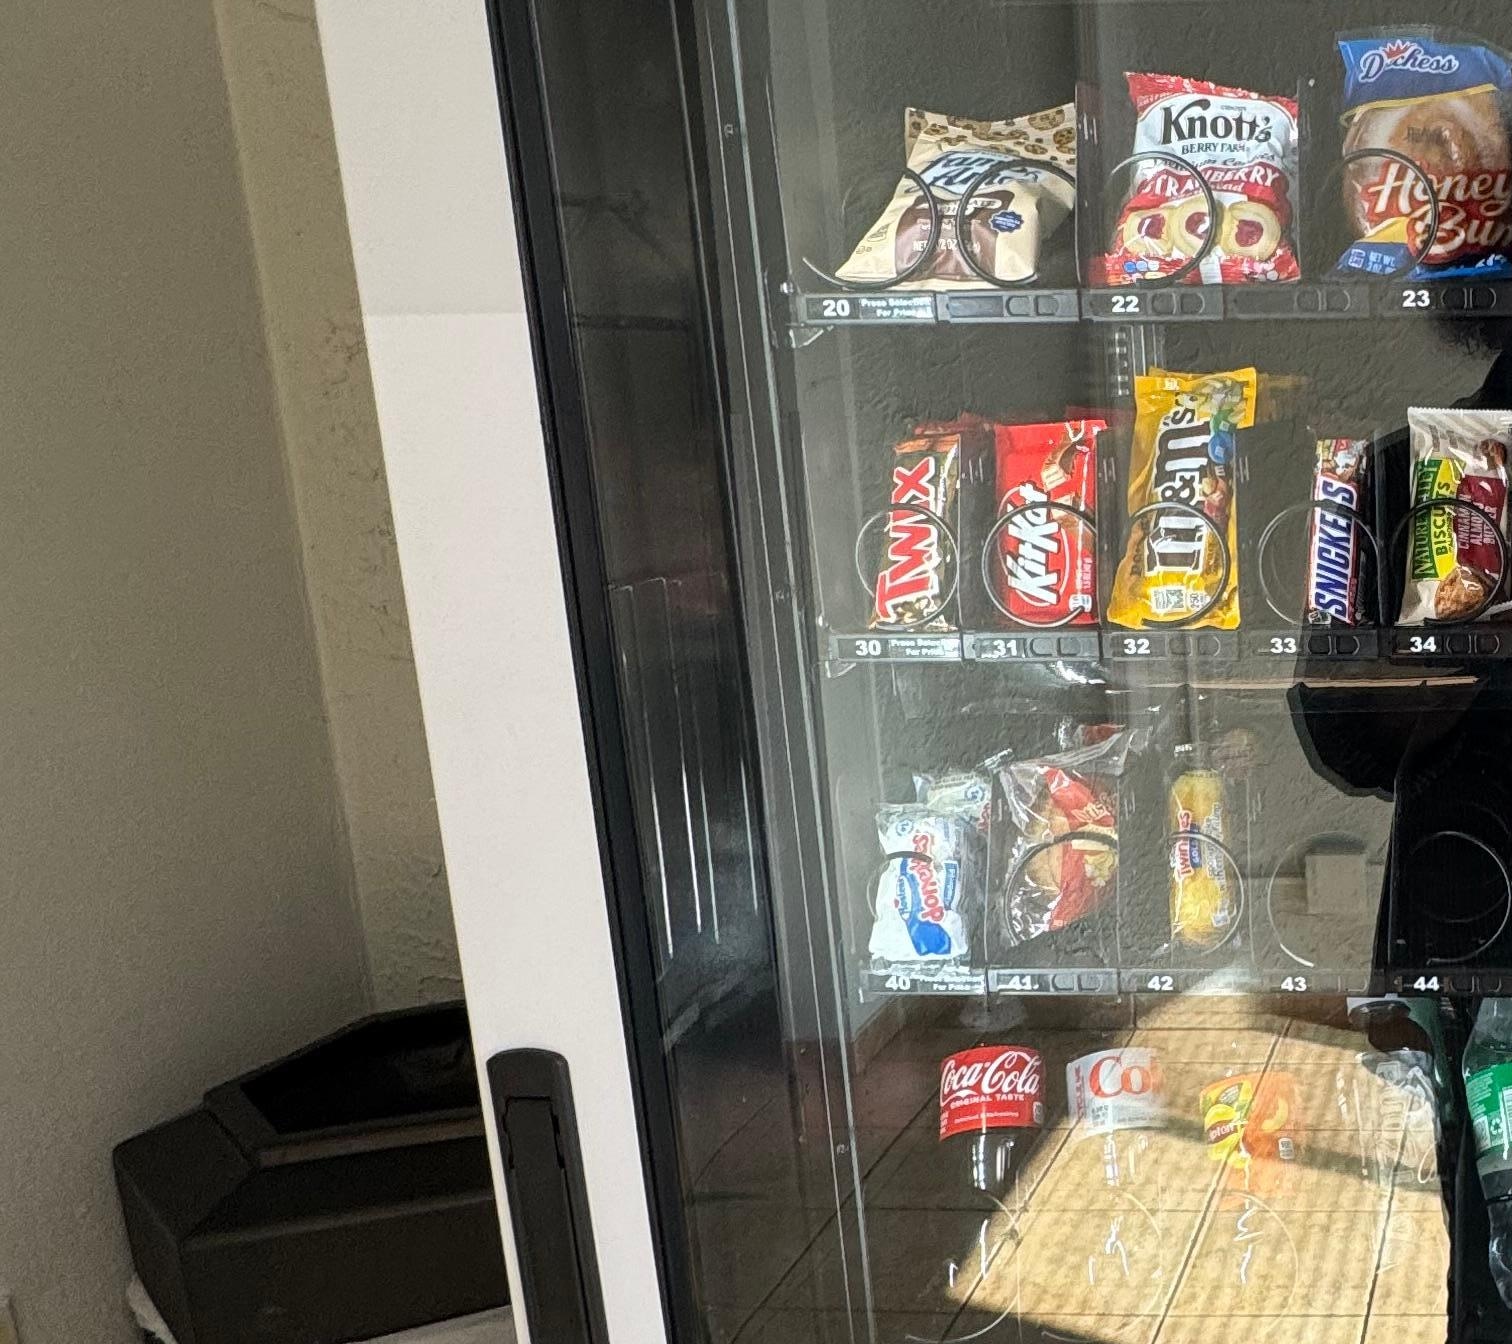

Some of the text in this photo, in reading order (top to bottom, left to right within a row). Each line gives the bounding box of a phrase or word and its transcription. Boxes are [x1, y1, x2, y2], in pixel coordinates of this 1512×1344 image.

[1161, 98, 1273, 145] Knott's
[1181, 142, 1219, 155] BERRY
[1111, 295, 1140, 313] 22
[1403, 289, 1431, 308] 23
[822, 299, 850, 317] 20
[1433, 481, 1451, 556] BISCUTS
[1314, 479, 1356, 619] SNICKES
[855, 640, 881, 656] 30
[993, 639, 1018, 655] 31
[1123, 638, 1151, 654] 32
[1270, 638, 1297, 654] 33
[1410, 636, 1437, 653] 34
[885, 976, 911, 991] 40
[1008, 976, 1032, 990] 41
[1147, 975, 1174, 991] 42
[1281, 976, 1308, 992] 43
[1413, 976, 1440, 991] 44
[939, 1050, 1041, 1107] Coca-Cola
[996, 1093, 1025, 1102] TASTE
